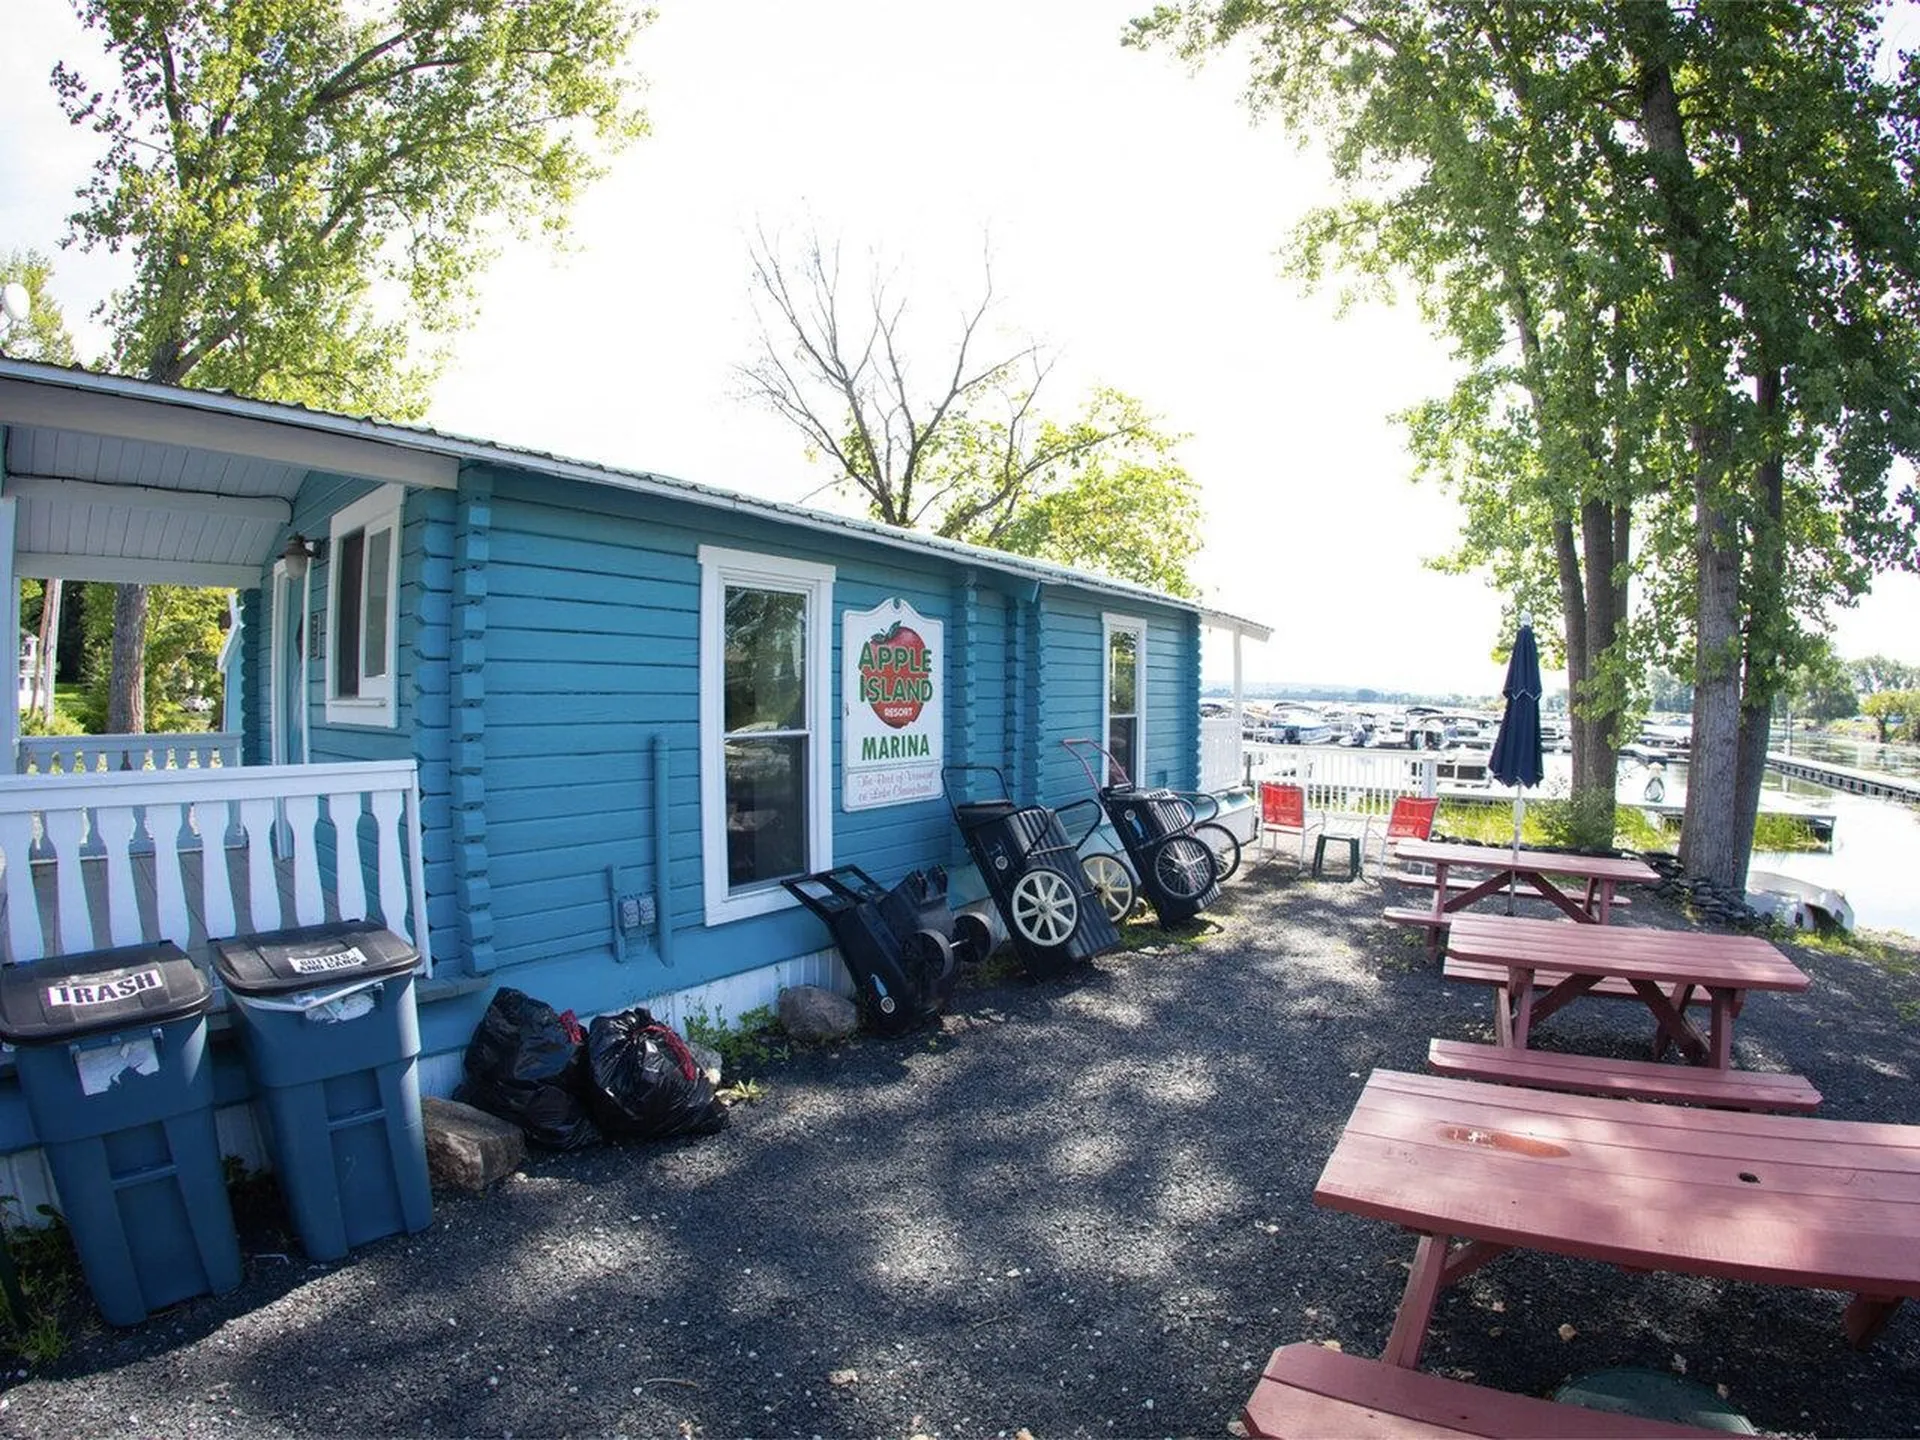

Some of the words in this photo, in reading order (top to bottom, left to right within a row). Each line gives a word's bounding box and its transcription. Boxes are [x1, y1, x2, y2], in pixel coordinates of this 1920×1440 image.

[858, 641, 933, 673] APPLE
[859, 674, 934, 703] ISLAND
[884, 706, 914, 718] RESORT
[861, 733, 930, 761] MARINA
[56, 972, 156, 1003] TRASH
